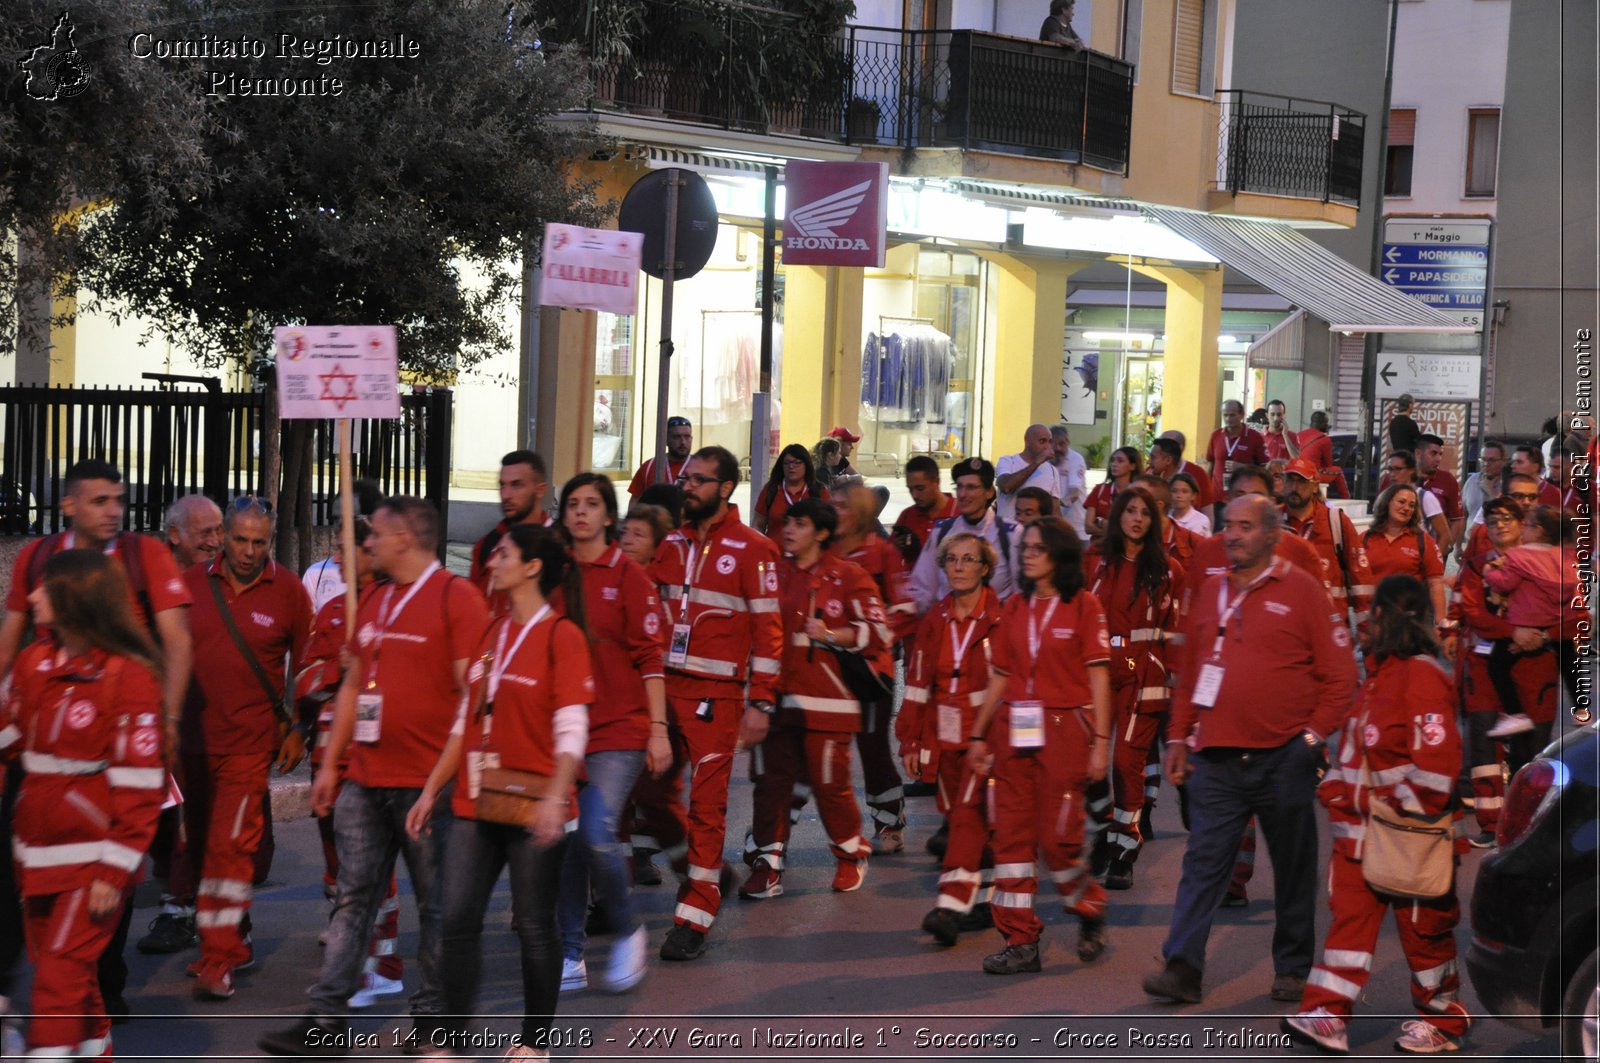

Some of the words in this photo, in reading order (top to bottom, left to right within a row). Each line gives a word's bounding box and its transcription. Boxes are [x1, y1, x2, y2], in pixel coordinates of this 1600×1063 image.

[1424, 231, 1461, 243] Maggio
[786, 237, 870, 251] HONDA
[1418, 250, 1485, 261] MORMANNO
[1409, 271, 1484, 282] PAPASIDERO
[1455, 294, 1482, 305] TALAO
[1419, 365, 1471, 373] NOBILI
[1392, 409, 1458, 422] SENDITA
